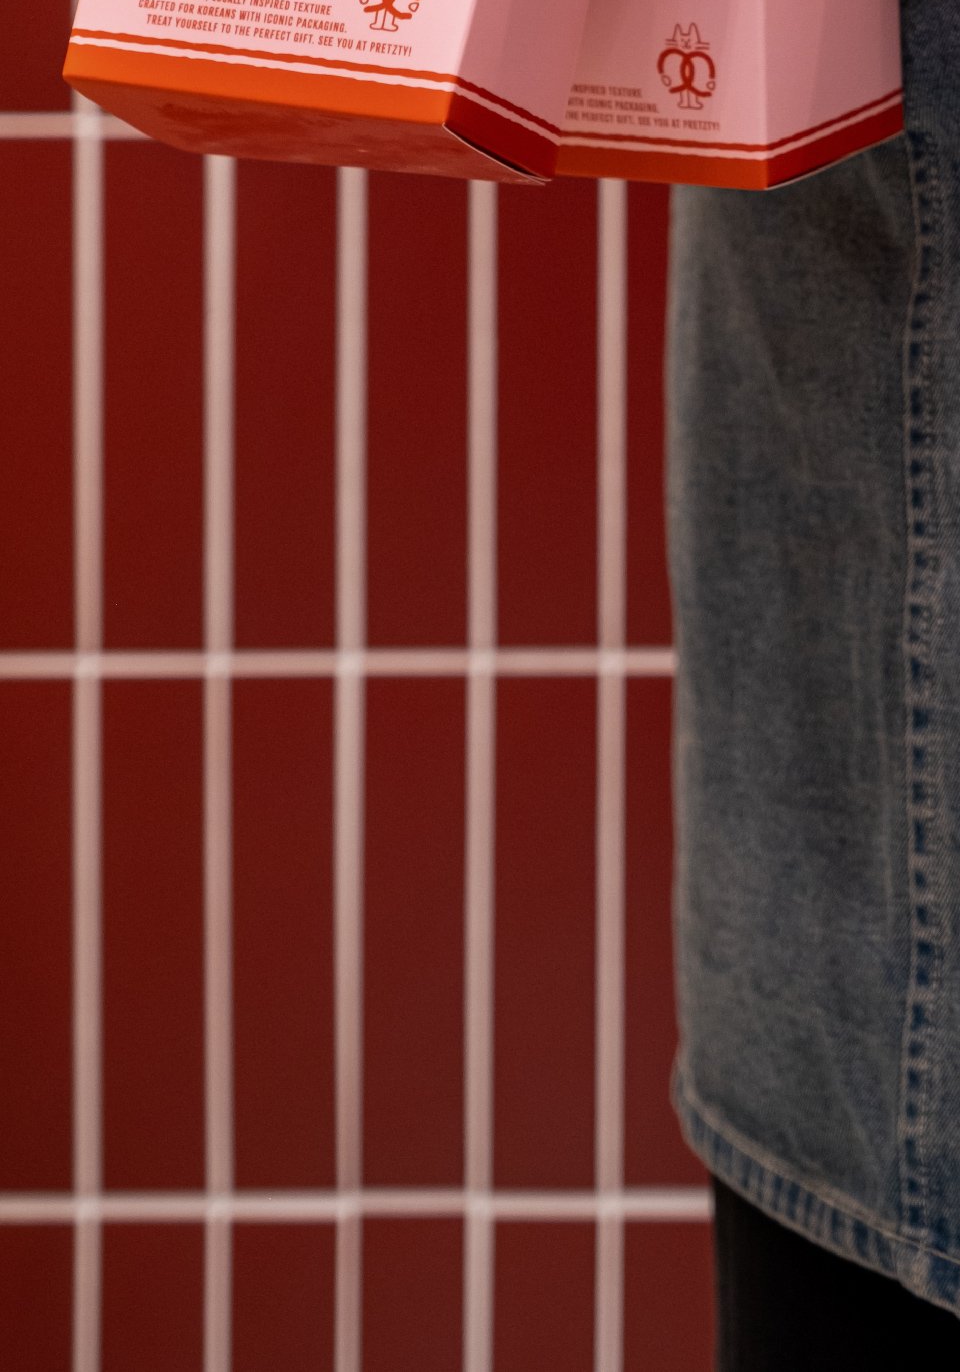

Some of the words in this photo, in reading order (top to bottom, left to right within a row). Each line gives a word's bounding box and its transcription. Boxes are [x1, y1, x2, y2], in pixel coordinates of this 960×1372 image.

[178, 3, 194, 14] FOR
[197, 5, 236, 20] KOREANS
[239, 10, 261, 23] WITH
[263, 13, 294, 26] ICONIC
[295, 18, 347, 33] PACKAGING.
[293, 1, 332, 16] TEXTURE
[146, 13, 172, 26] TREAT
[175, 18, 219, 33] YOURSELF
[221, 23, 231, 34] TO
[234, 25, 251, 36] THE
[253, 27, 291, 41] PERFECT
[293, 32, 315, 45] GIFT.
[318, 35, 334, 47] SEE
[337, 38, 354, 50] YOU
[355, 40, 368, 51] AT
[369, 42, 412, 57] PRETZTY!
